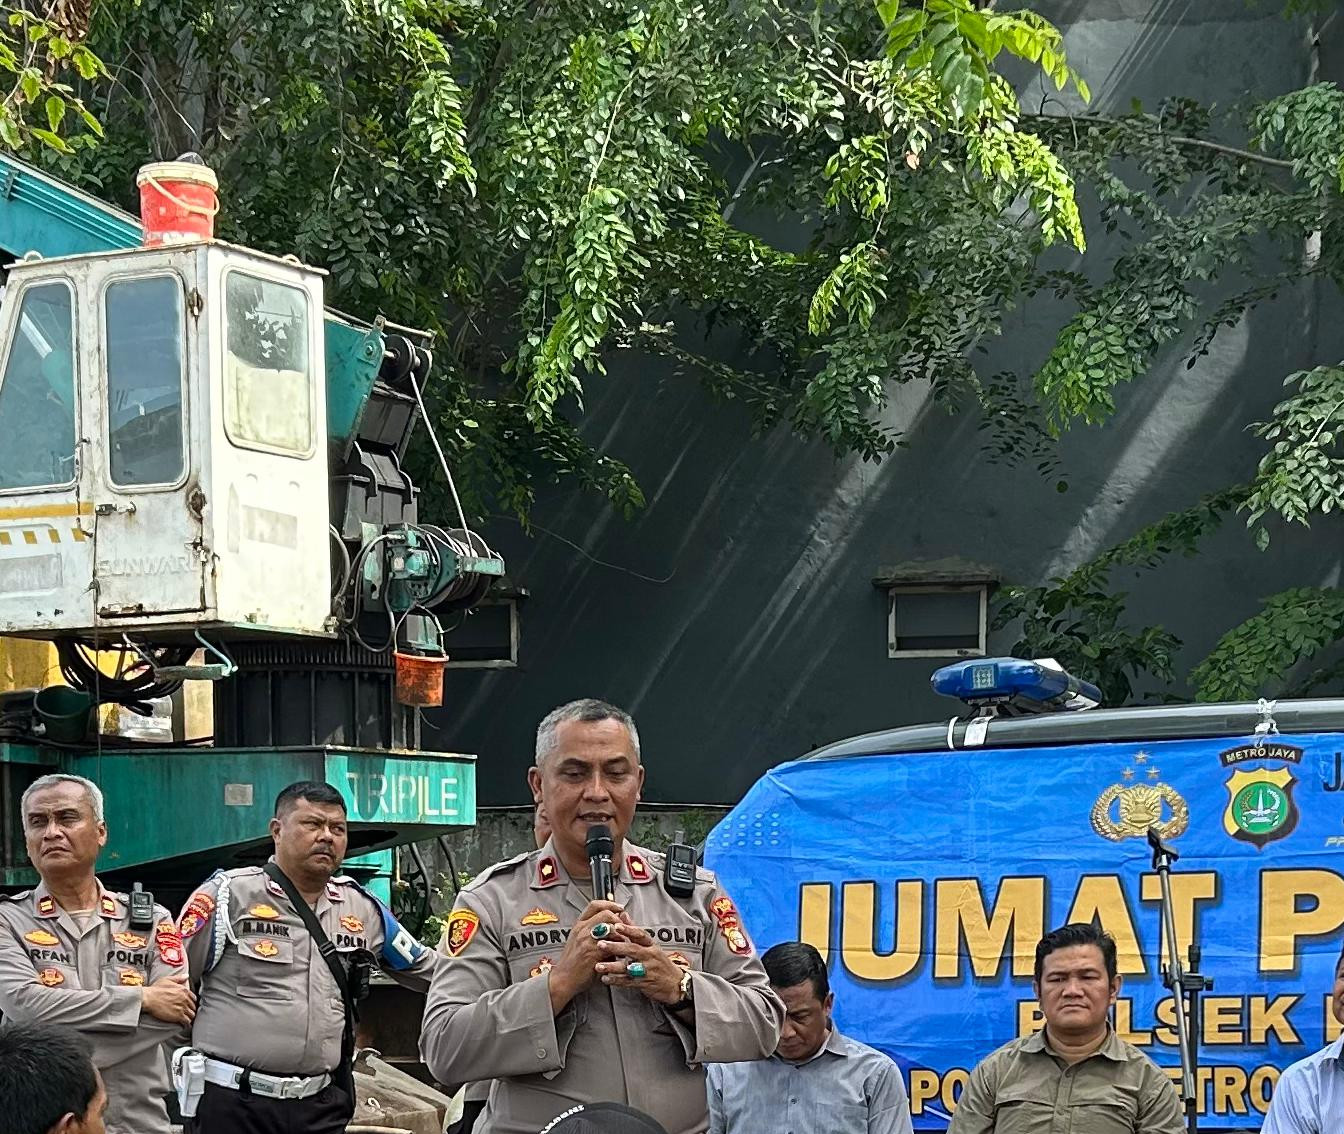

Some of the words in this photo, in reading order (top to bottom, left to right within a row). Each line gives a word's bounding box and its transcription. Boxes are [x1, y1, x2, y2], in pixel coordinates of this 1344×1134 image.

[1226, 747, 1266, 763] METRO
[1269, 747, 1295, 760] JAYA
[800, 871, 1216, 981] JUMAT
[336, 934, 367, 949] POLRI
[27, 948, 70, 963] RFAN
[107, 949, 149, 966] POLRI
[1017, 992, 1305, 1046] PLSEK
